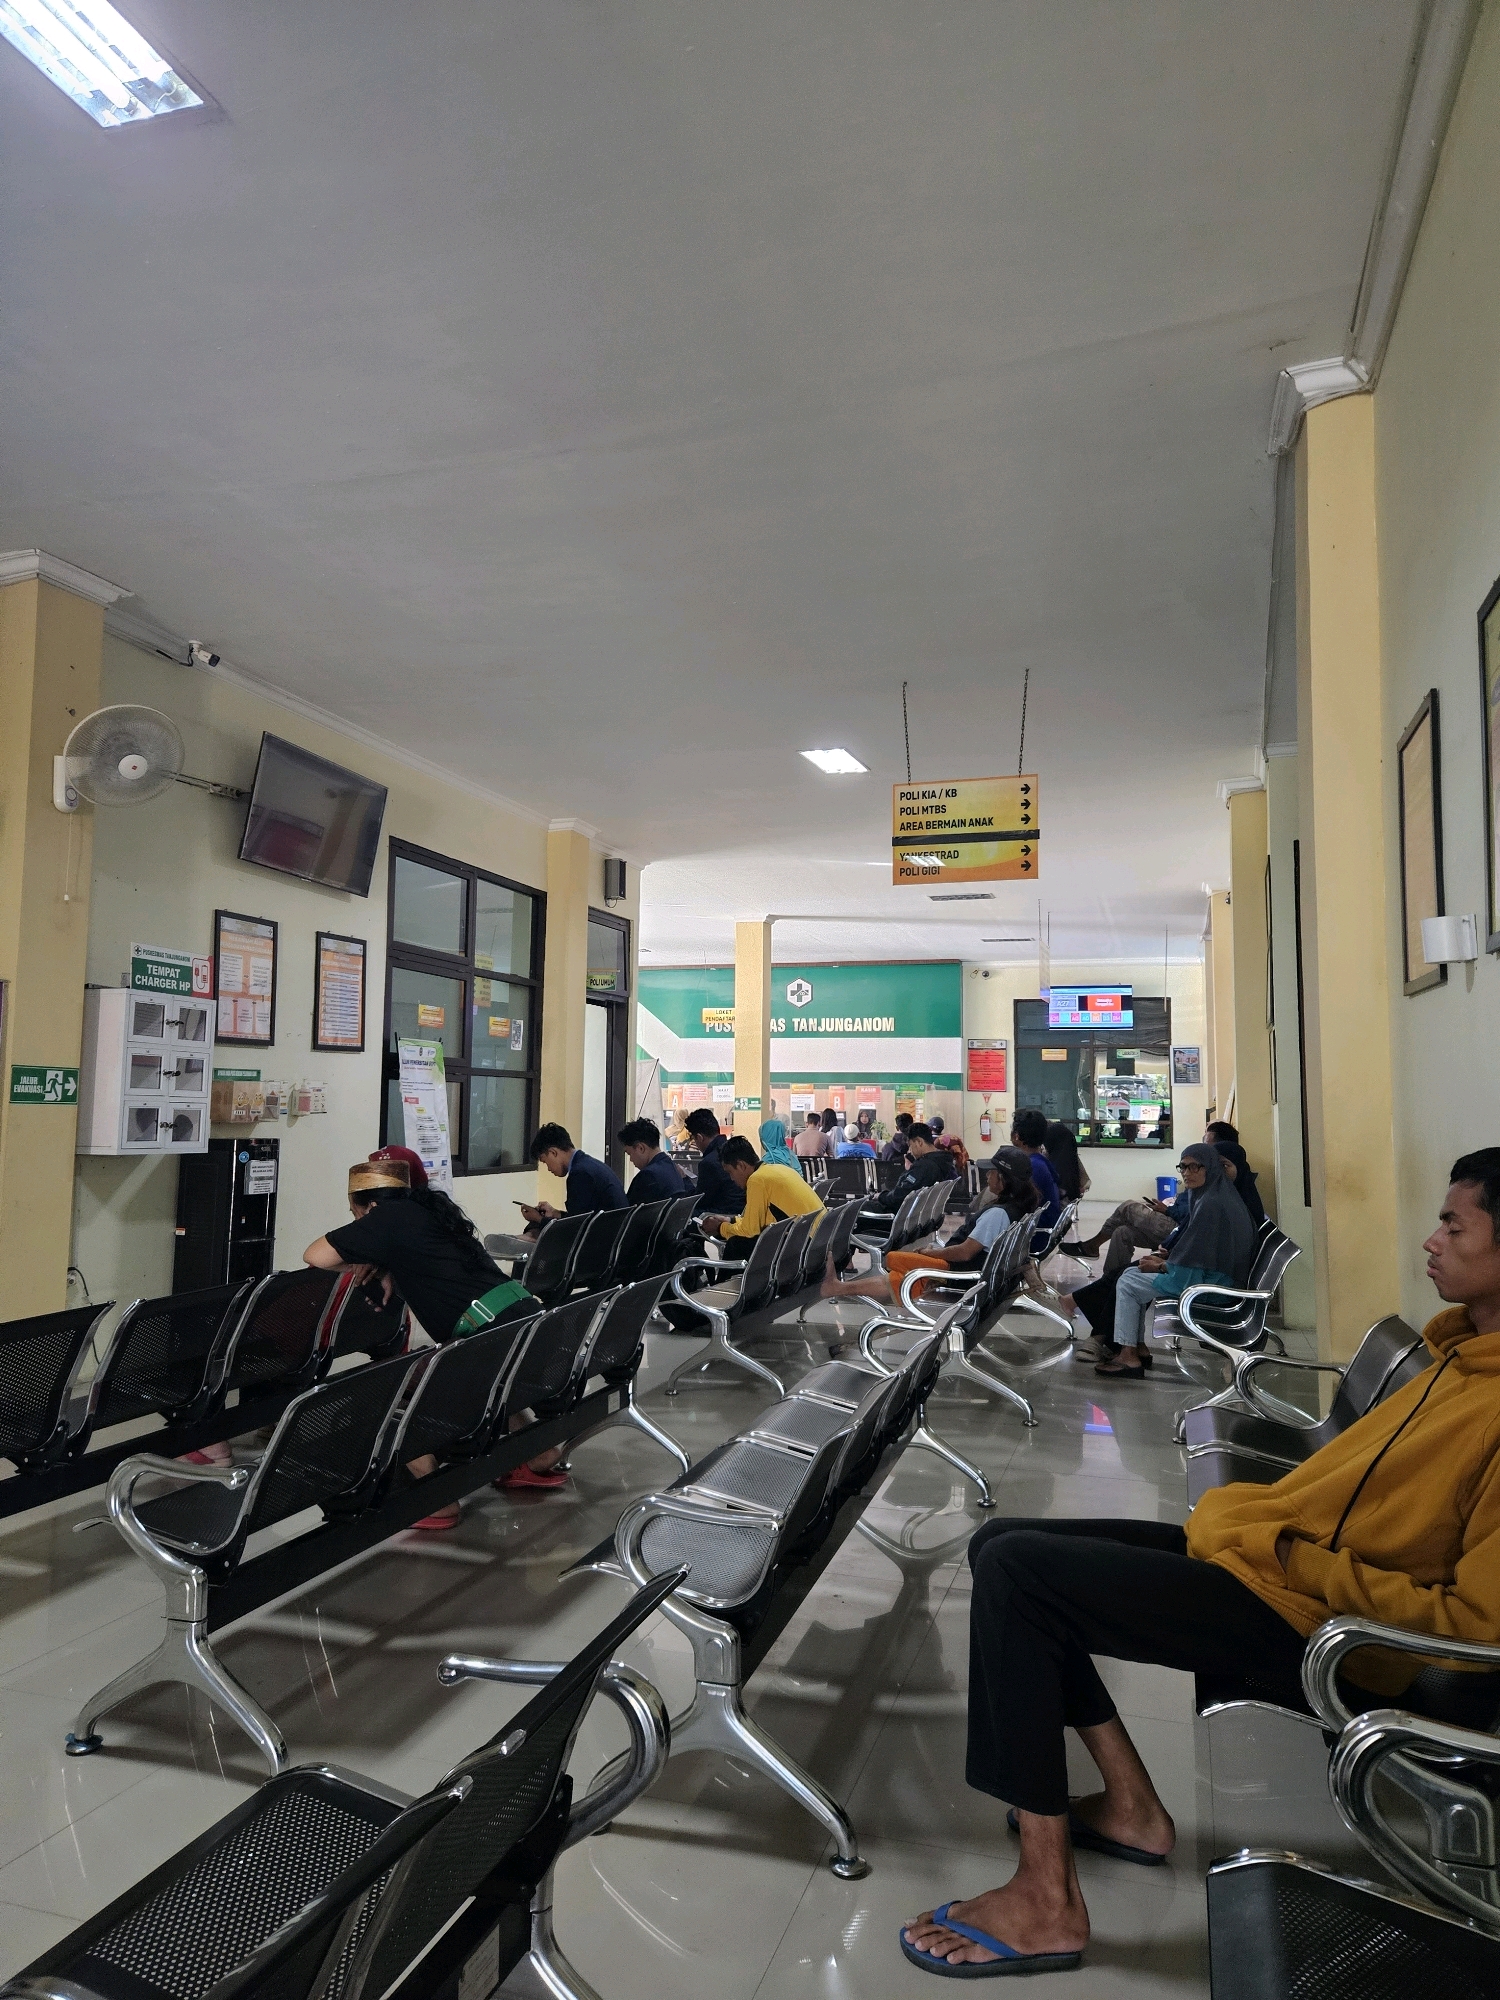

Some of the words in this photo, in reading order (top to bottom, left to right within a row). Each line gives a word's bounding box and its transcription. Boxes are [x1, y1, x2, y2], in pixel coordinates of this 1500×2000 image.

[899, 790, 920, 801] POLI
[921, 789, 937, 800] KIA
[945, 788, 957, 798] KB
[899, 806, 920, 816] POLI
[921, 805, 947, 815] MTBS
[899, 820, 924, 831] AREA
[925, 818, 967, 830] BERMAIN
[968, 817, 994, 828] ANAK
[899, 866, 920, 877] POLI
[921, 865, 941, 876] GIGI
[146, 963, 181, 979] TEMPAT
[135, 974, 177, 990] CHARGER
[179, 980, 191, 992] HP
[589, 978, 600, 986] POLI
[792, 1017, 895, 1032] TANJUNGANOM
[19, 1076, 39, 1085] JALUR
[13, 1084, 44, 1094] EVAKUASI
[672, 1094, 679, 1108] A
[833, 1096, 841, 1109] B
